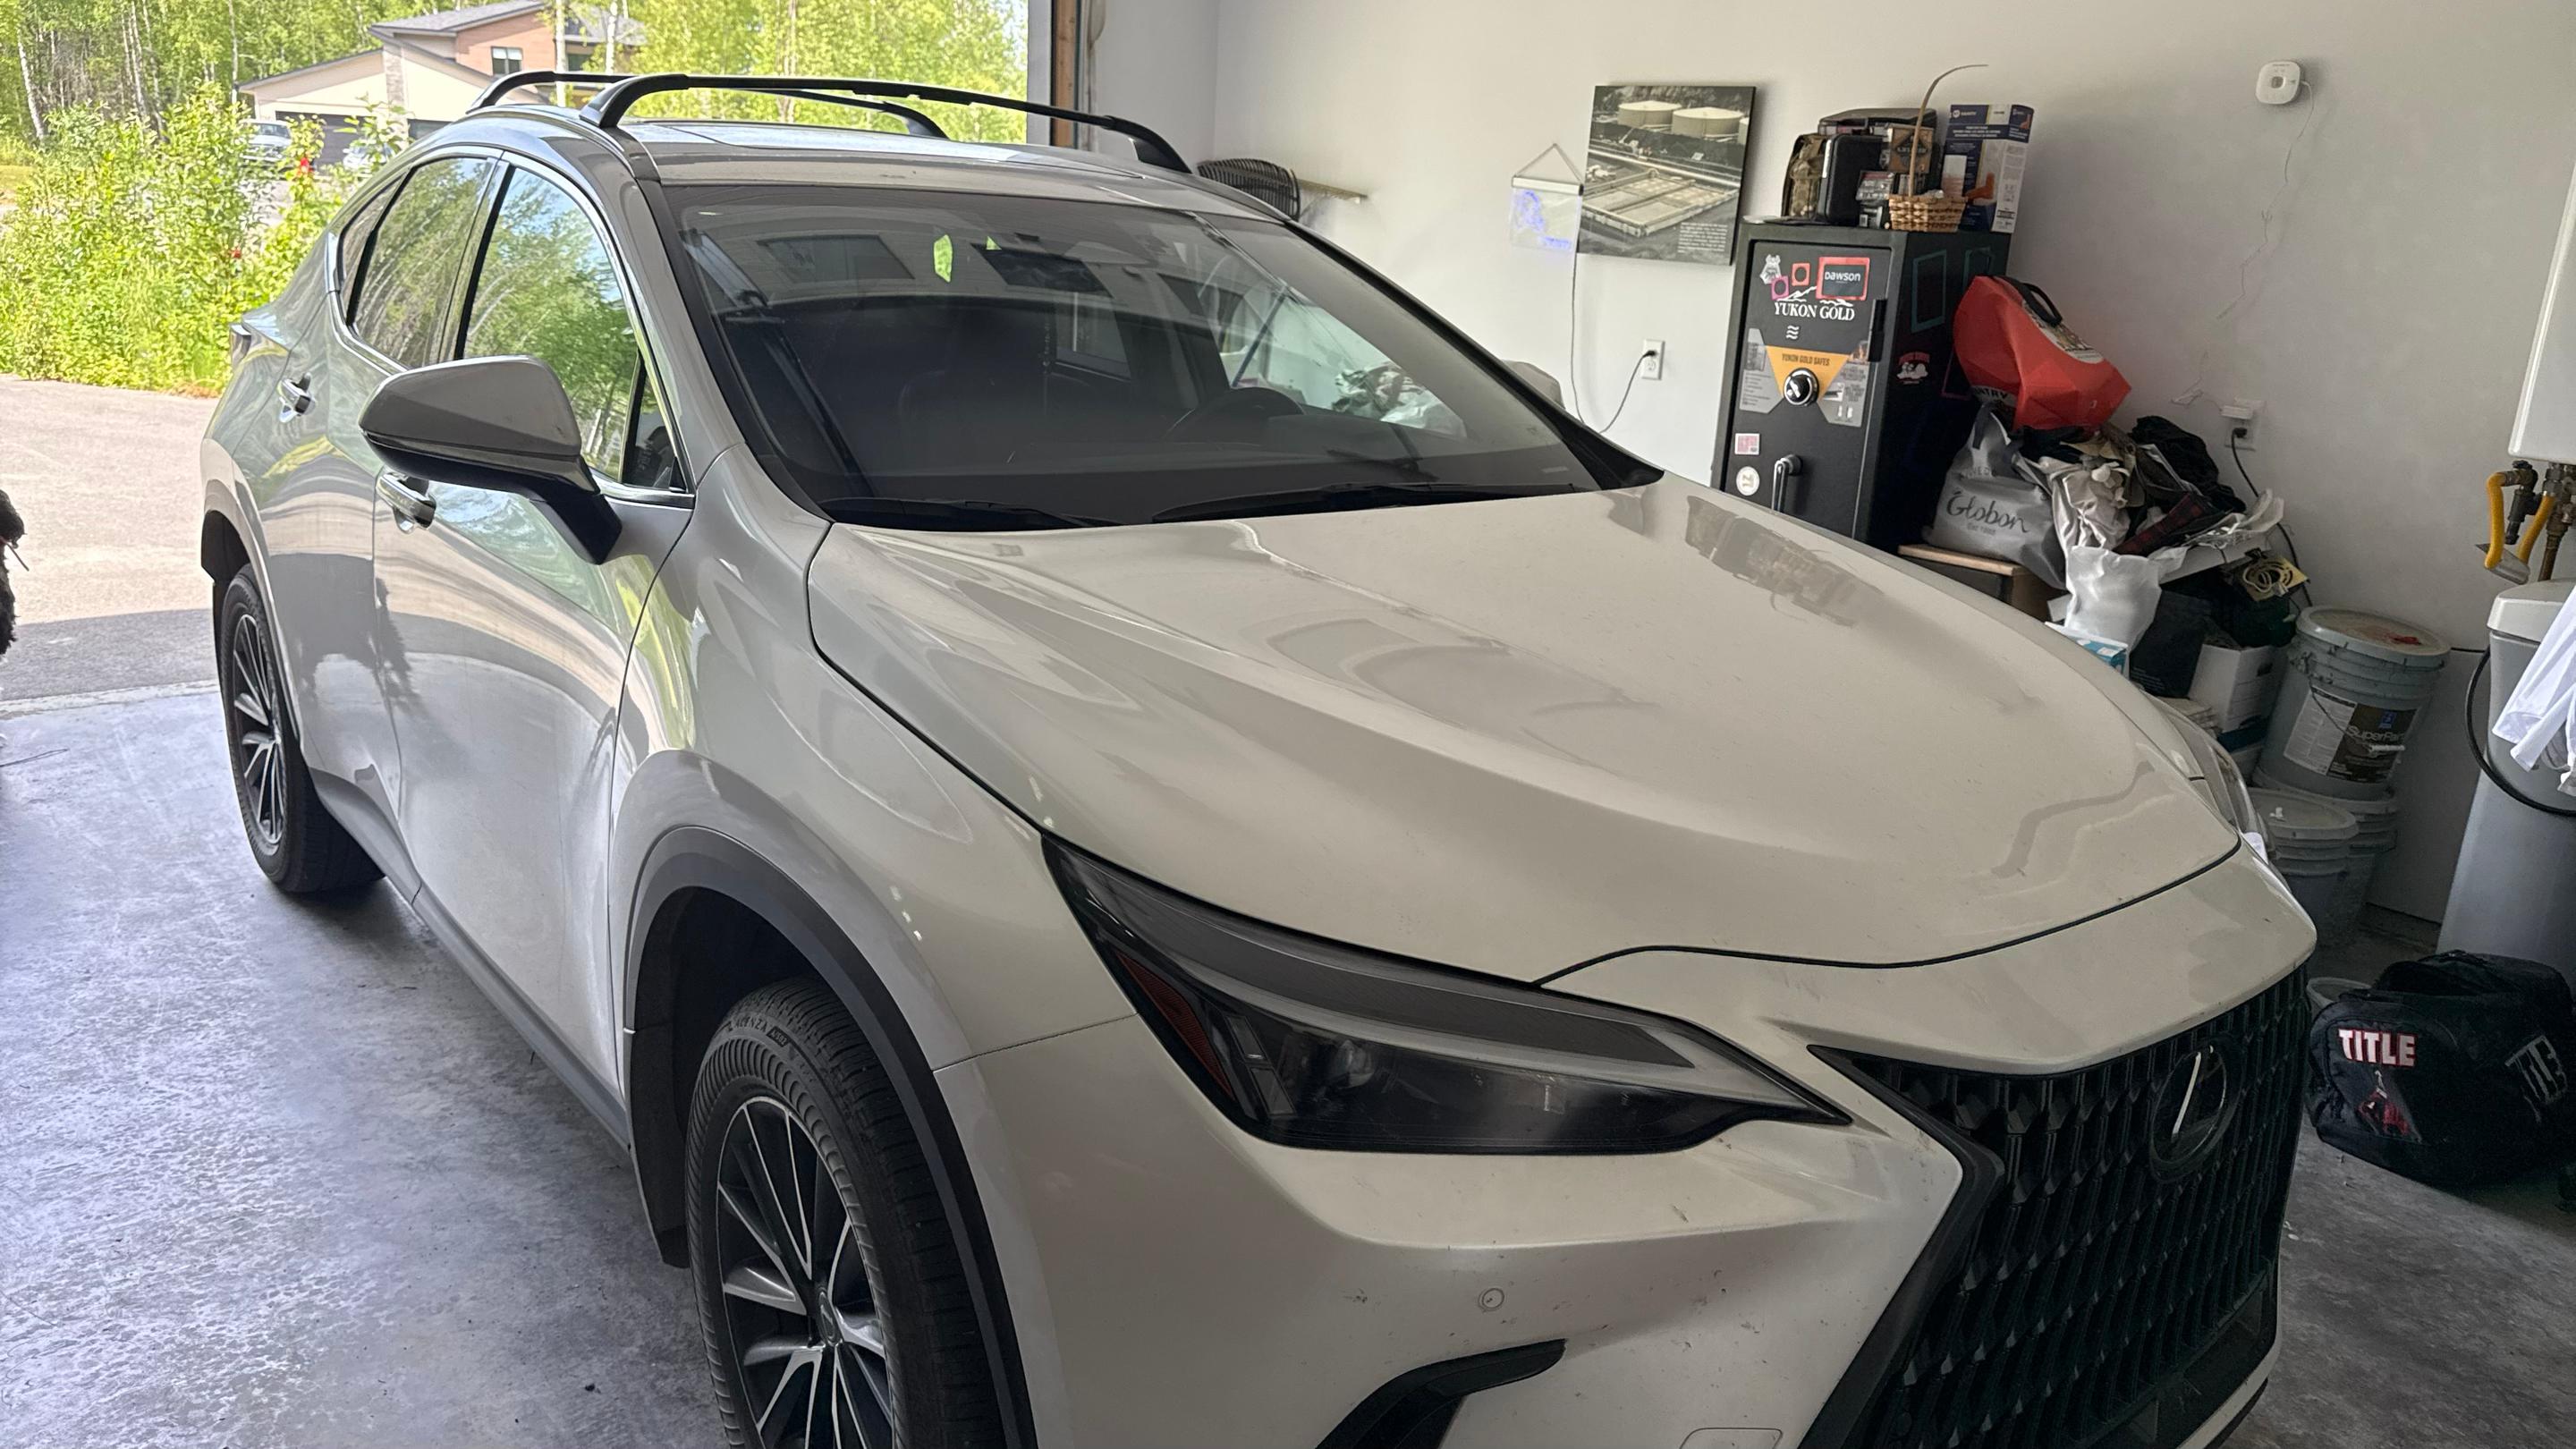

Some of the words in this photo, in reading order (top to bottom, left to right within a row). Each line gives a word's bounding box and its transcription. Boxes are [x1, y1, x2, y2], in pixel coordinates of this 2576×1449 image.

[1774, 301, 1818, 318] YUKON
[1819, 305, 1855, 321] GOLD
[1782, 353, 1799, 363] YUKON
[1800, 355, 1813, 365] GOLD
[1814, 357, 1830, 367] SAFES
[2337, 1027, 2417, 1068] TITLE
